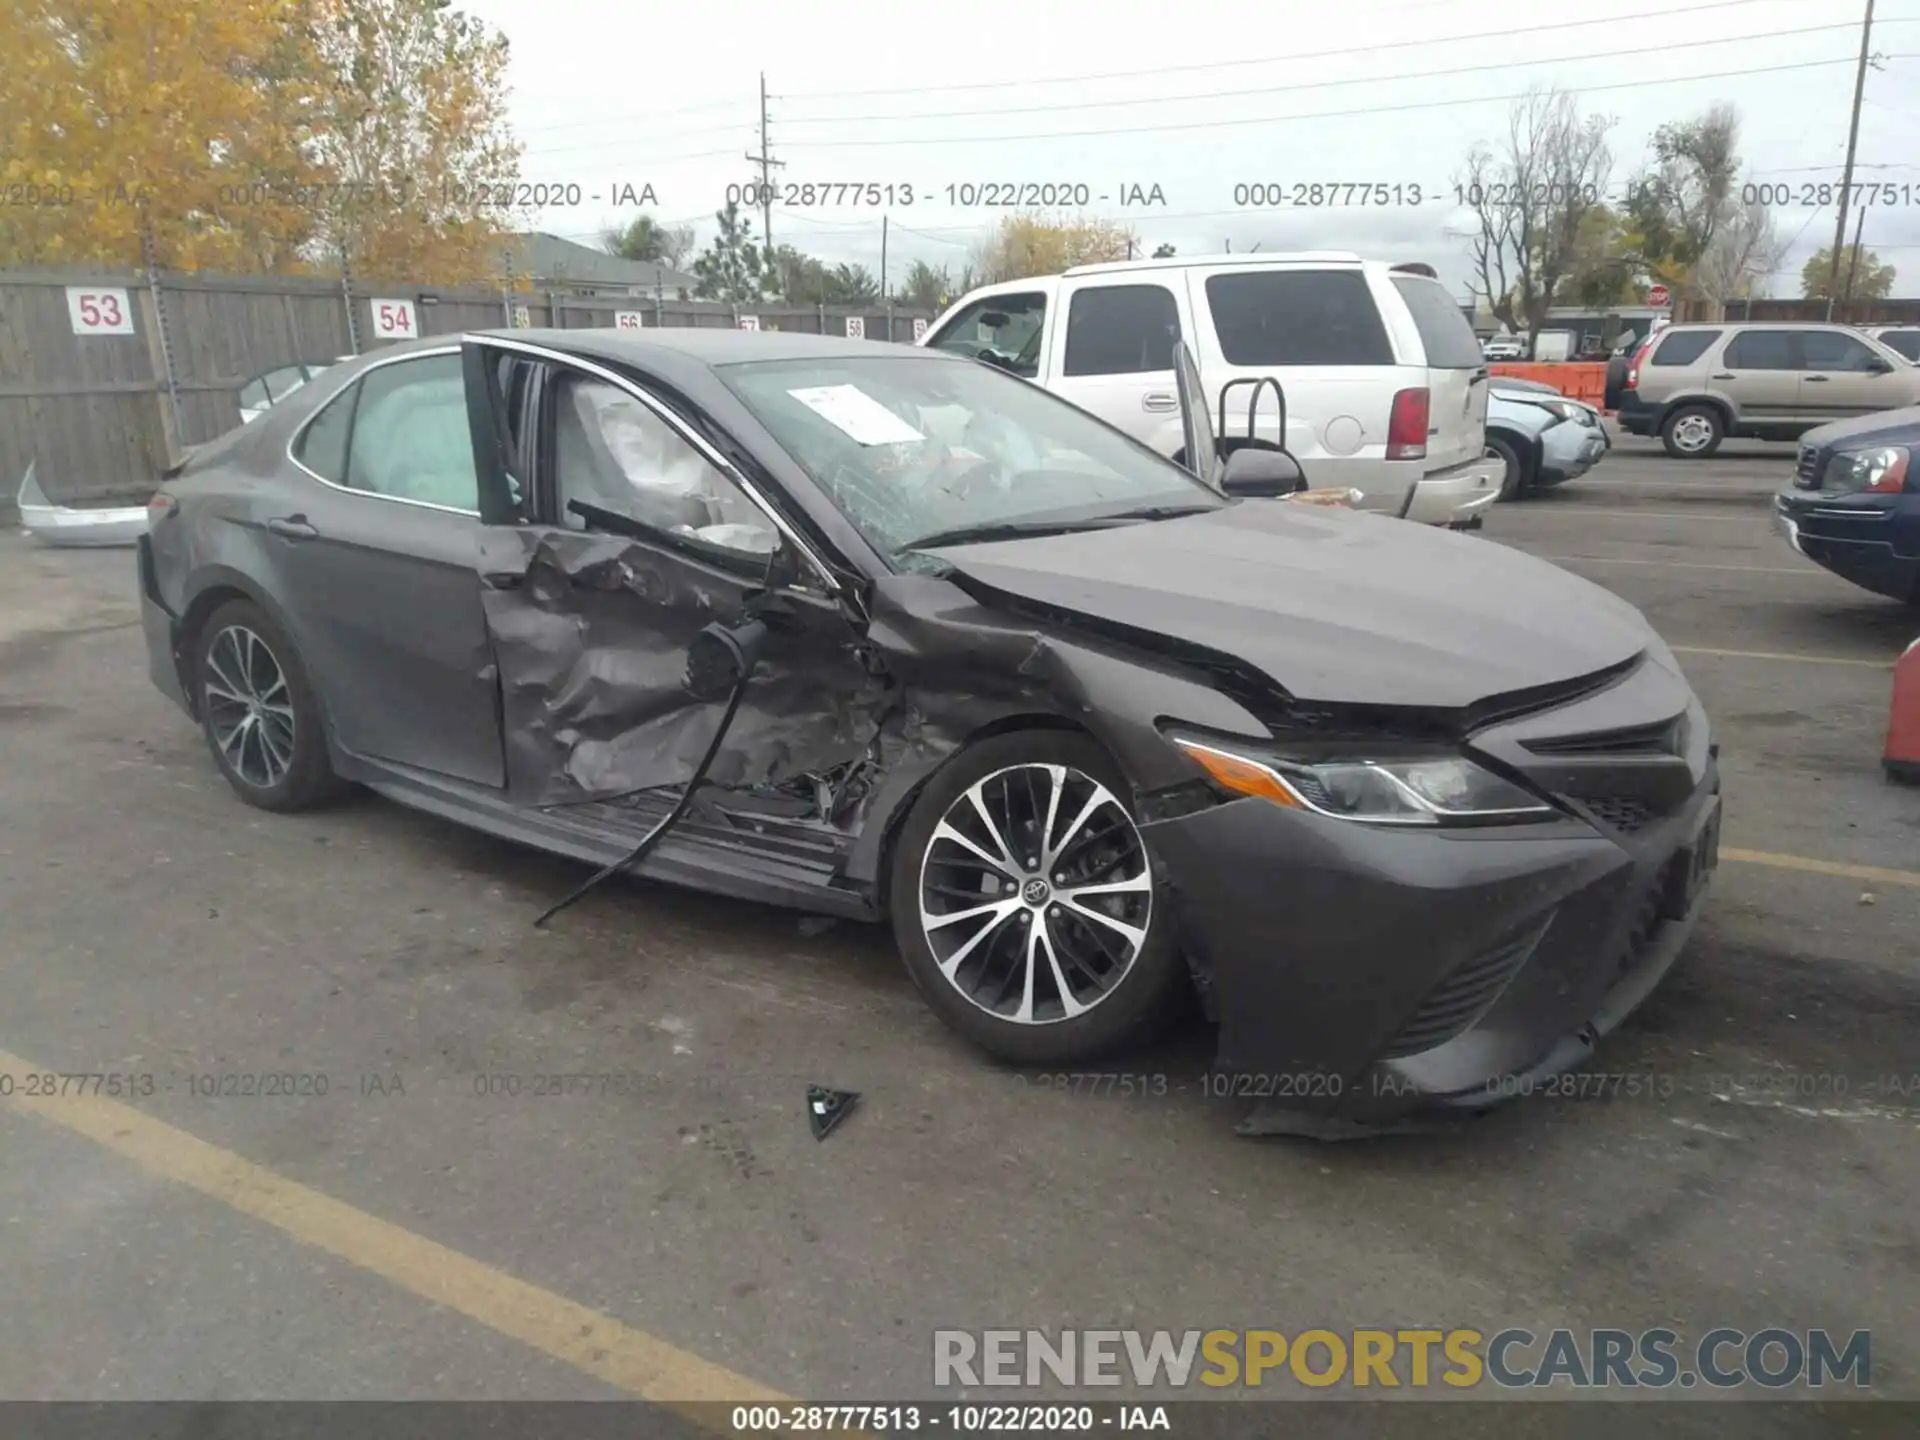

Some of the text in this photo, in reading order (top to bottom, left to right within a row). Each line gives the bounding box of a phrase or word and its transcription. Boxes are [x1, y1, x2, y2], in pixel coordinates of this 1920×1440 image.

[79, 295, 122, 327] 53
[380, 305, 411, 332] 54
[849, 320, 862, 337] 58
